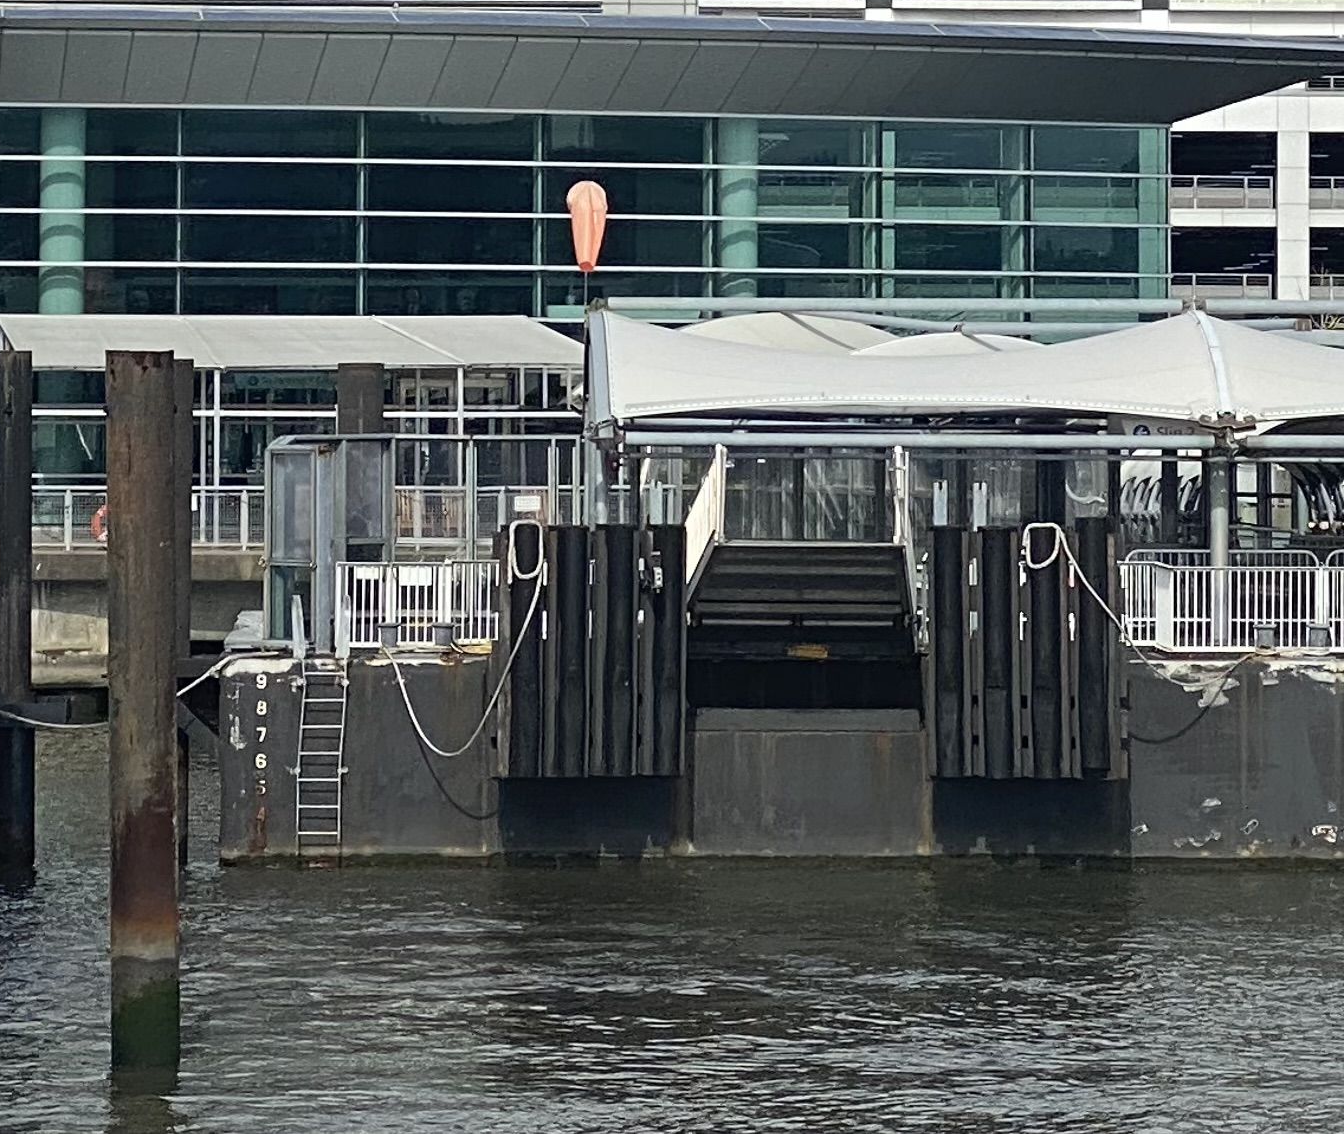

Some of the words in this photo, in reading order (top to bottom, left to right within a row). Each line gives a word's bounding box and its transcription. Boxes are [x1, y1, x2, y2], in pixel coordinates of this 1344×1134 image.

[256, 674, 267, 690] 9
[256, 700, 267, 716] 8
[256, 727, 267, 742] 7
[256, 754, 267, 769] 6
